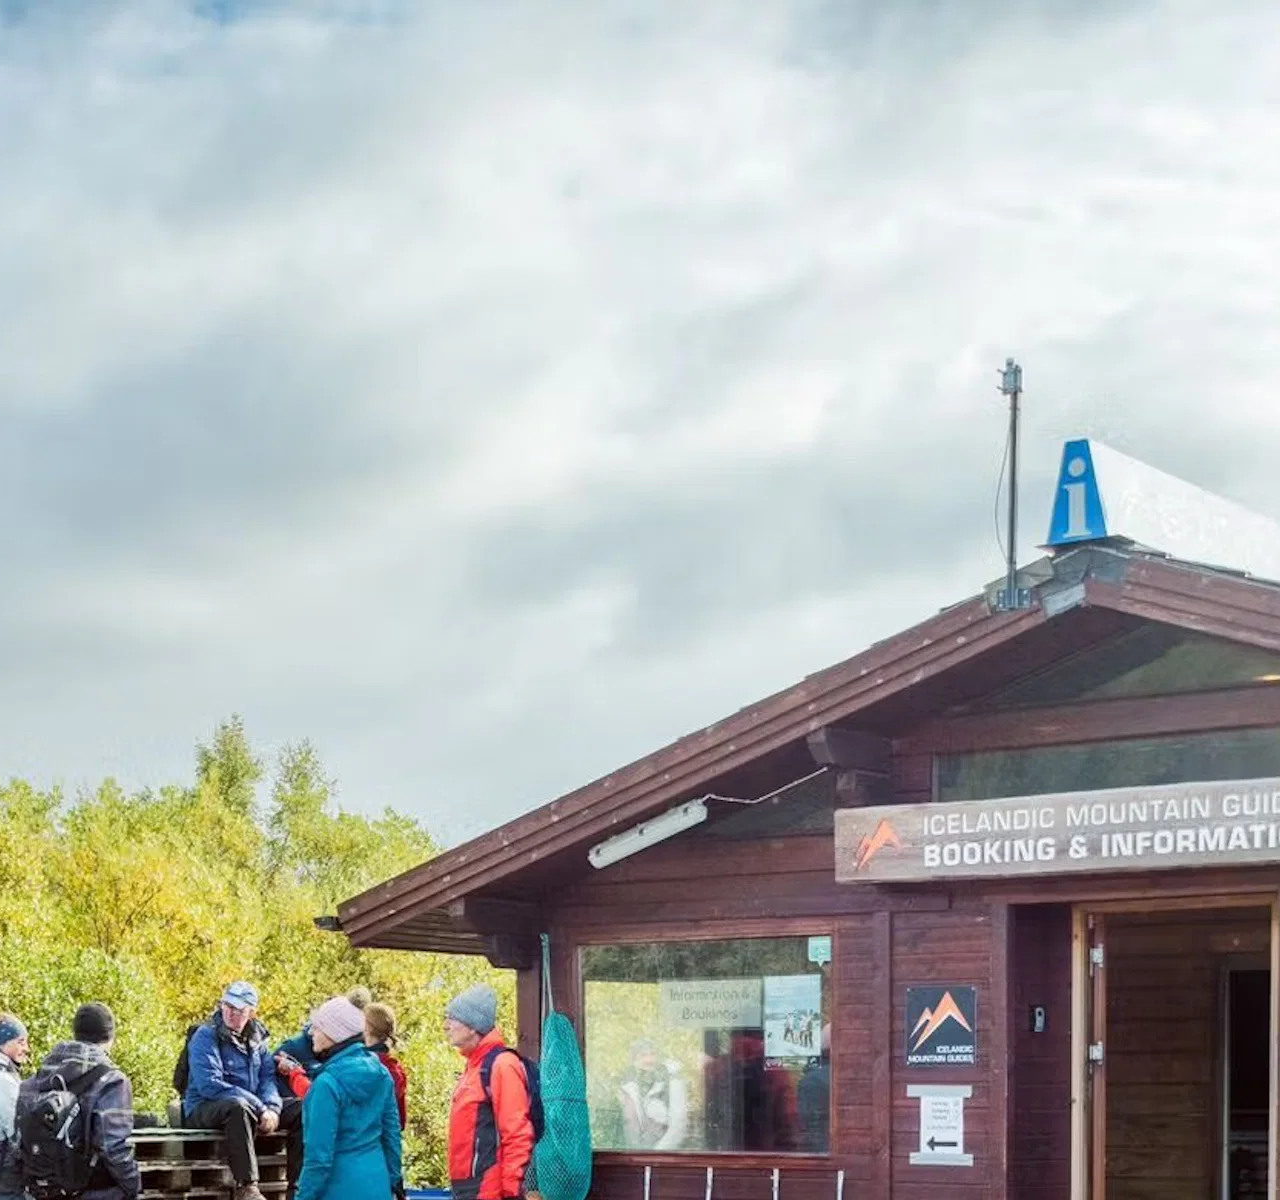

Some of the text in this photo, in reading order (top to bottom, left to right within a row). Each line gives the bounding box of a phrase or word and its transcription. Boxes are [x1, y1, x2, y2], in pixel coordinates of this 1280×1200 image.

[923, 807, 1056, 836] ICELANDIC
[1066, 796, 1210, 827] MOUNTAIN
[923, 836, 1056, 867] BOOKING
[1068, 833, 1090, 859] &
[908, 1054, 974, 1063] MOUNTAIN GUIDES
